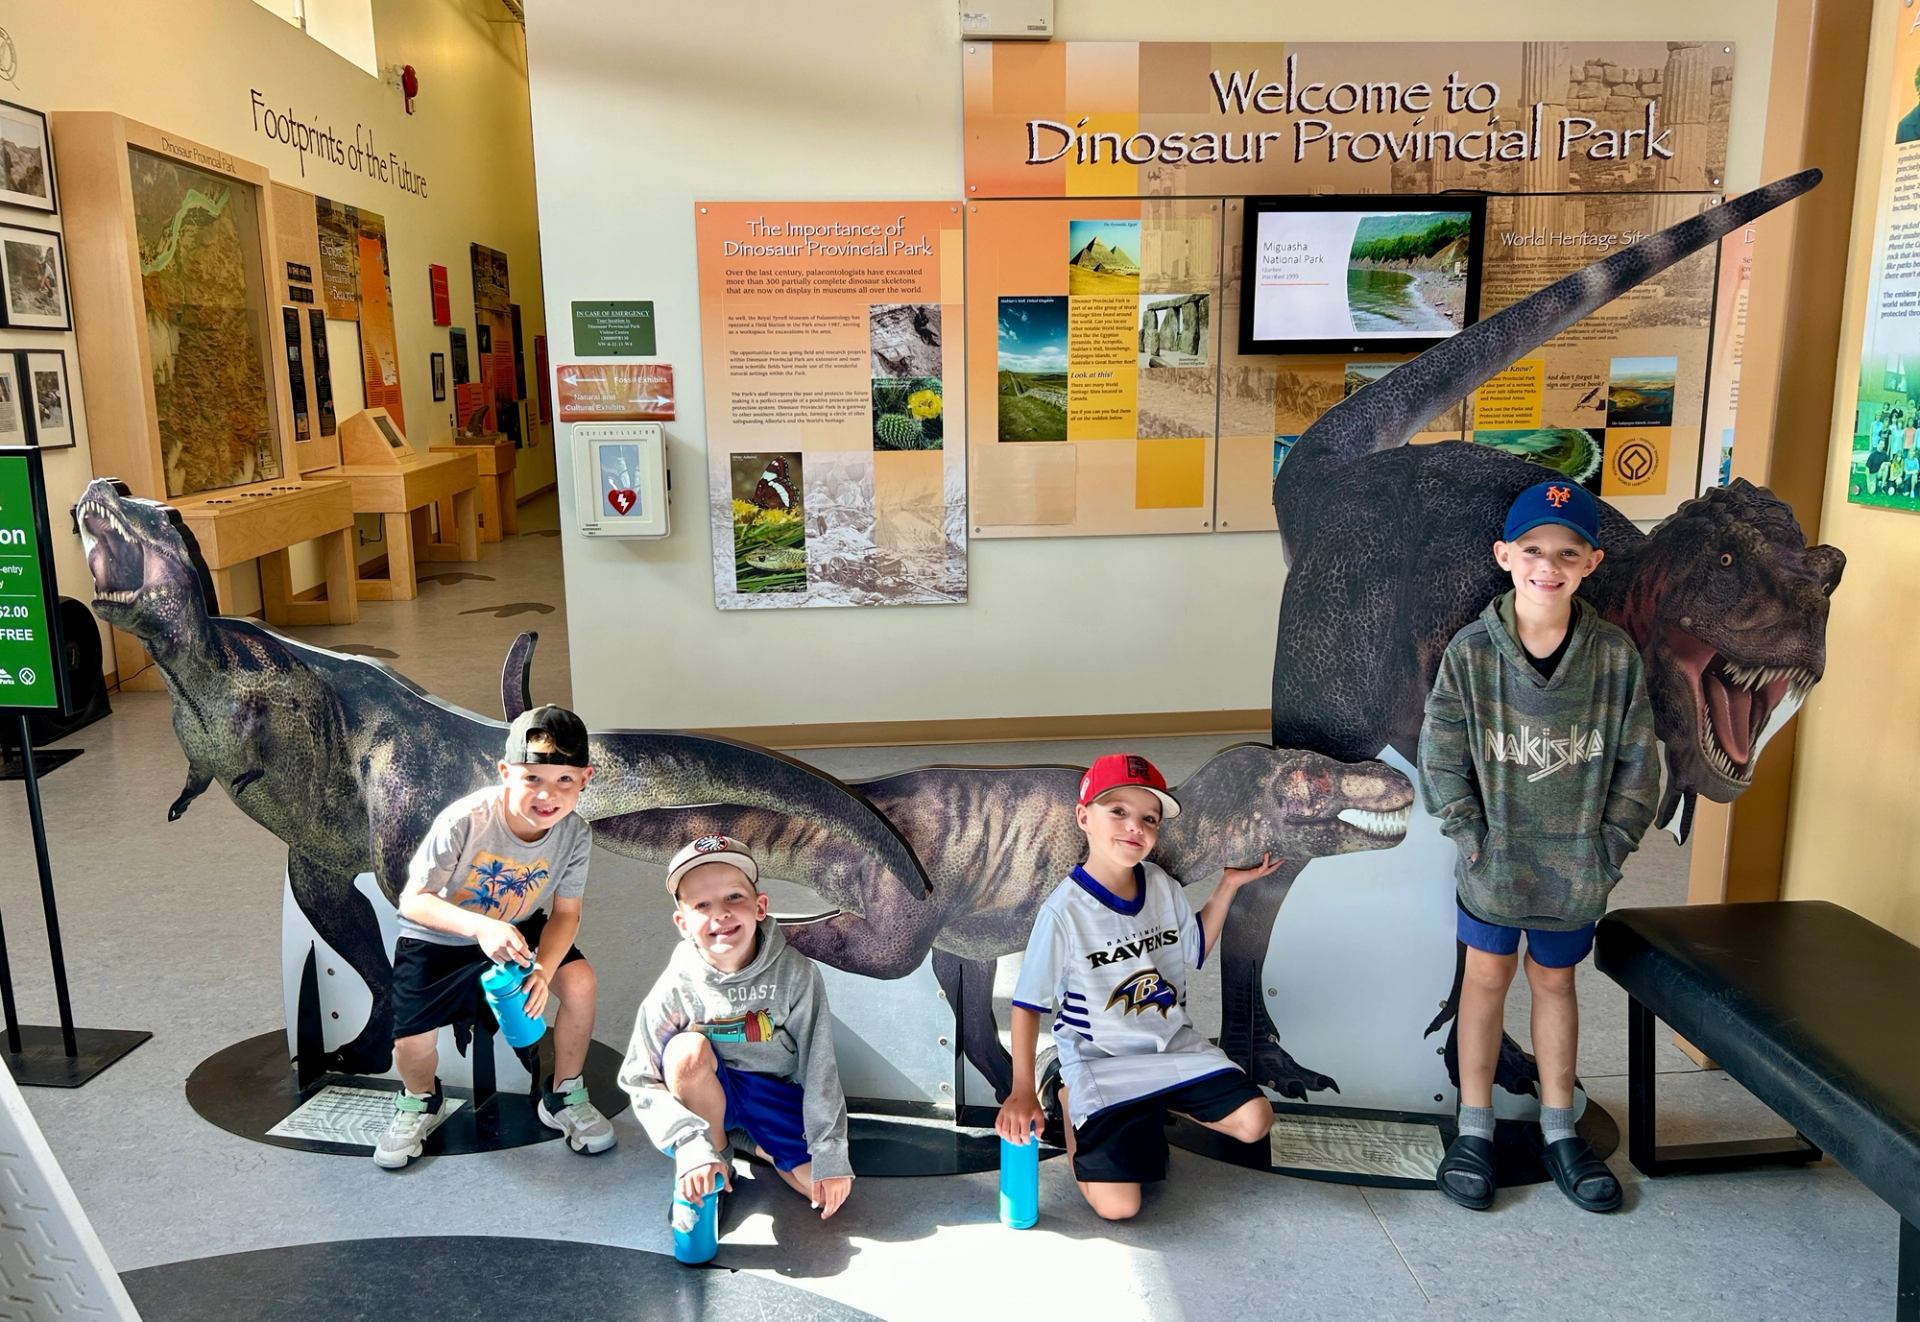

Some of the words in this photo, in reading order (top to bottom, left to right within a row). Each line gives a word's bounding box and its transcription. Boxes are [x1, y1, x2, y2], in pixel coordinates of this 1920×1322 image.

[1209, 52, 1432, 115] Welcome
[1443, 70, 1500, 114] to
[1025, 116, 1281, 165] Dinosaur
[1293, 101, 1543, 163] Provincial
[1557, 100, 1675, 162] Park
[250, 88, 344, 178] Footprints
[348, 123, 364, 172] of
[366, 129, 388, 183] the
[389, 152, 428, 199] Future
[161, 136, 192, 158] Dinosaur
[193, 147, 221, 169] Provincial
[222, 157, 237, 174] Park
[1898, 153, 1920, 165] symbol
[746, 216, 782, 237] The
[786, 221, 881, 245] Importance
[885, 216, 906, 237] of
[1500, 226, 1547, 246] World
[1550, 230, 1618, 252] Heritage
[723, 240, 804, 257] Dinosaur
[807, 236, 888, 257] Provincial
[893, 235, 933, 257] Park
[1263, 242, 1308, 253] Miguasha
[1262, 254, 1302, 264] National
[1304, 254, 1324, 264] Park
[774, 269, 804, 277] century,
[806, 268, 865, 277] palaeontologists
[782, 278, 811, 286] partially
[813, 278, 846, 286] complete
[786, 287, 812, 295] display
[1881, 310, 1908, 318] protected
[0, 528, 26, 545] on
[0, 629, 34, 640] FREE
[1086, 930, 1178, 970] RAVENS
[728, 984, 777, 1002] COAST
